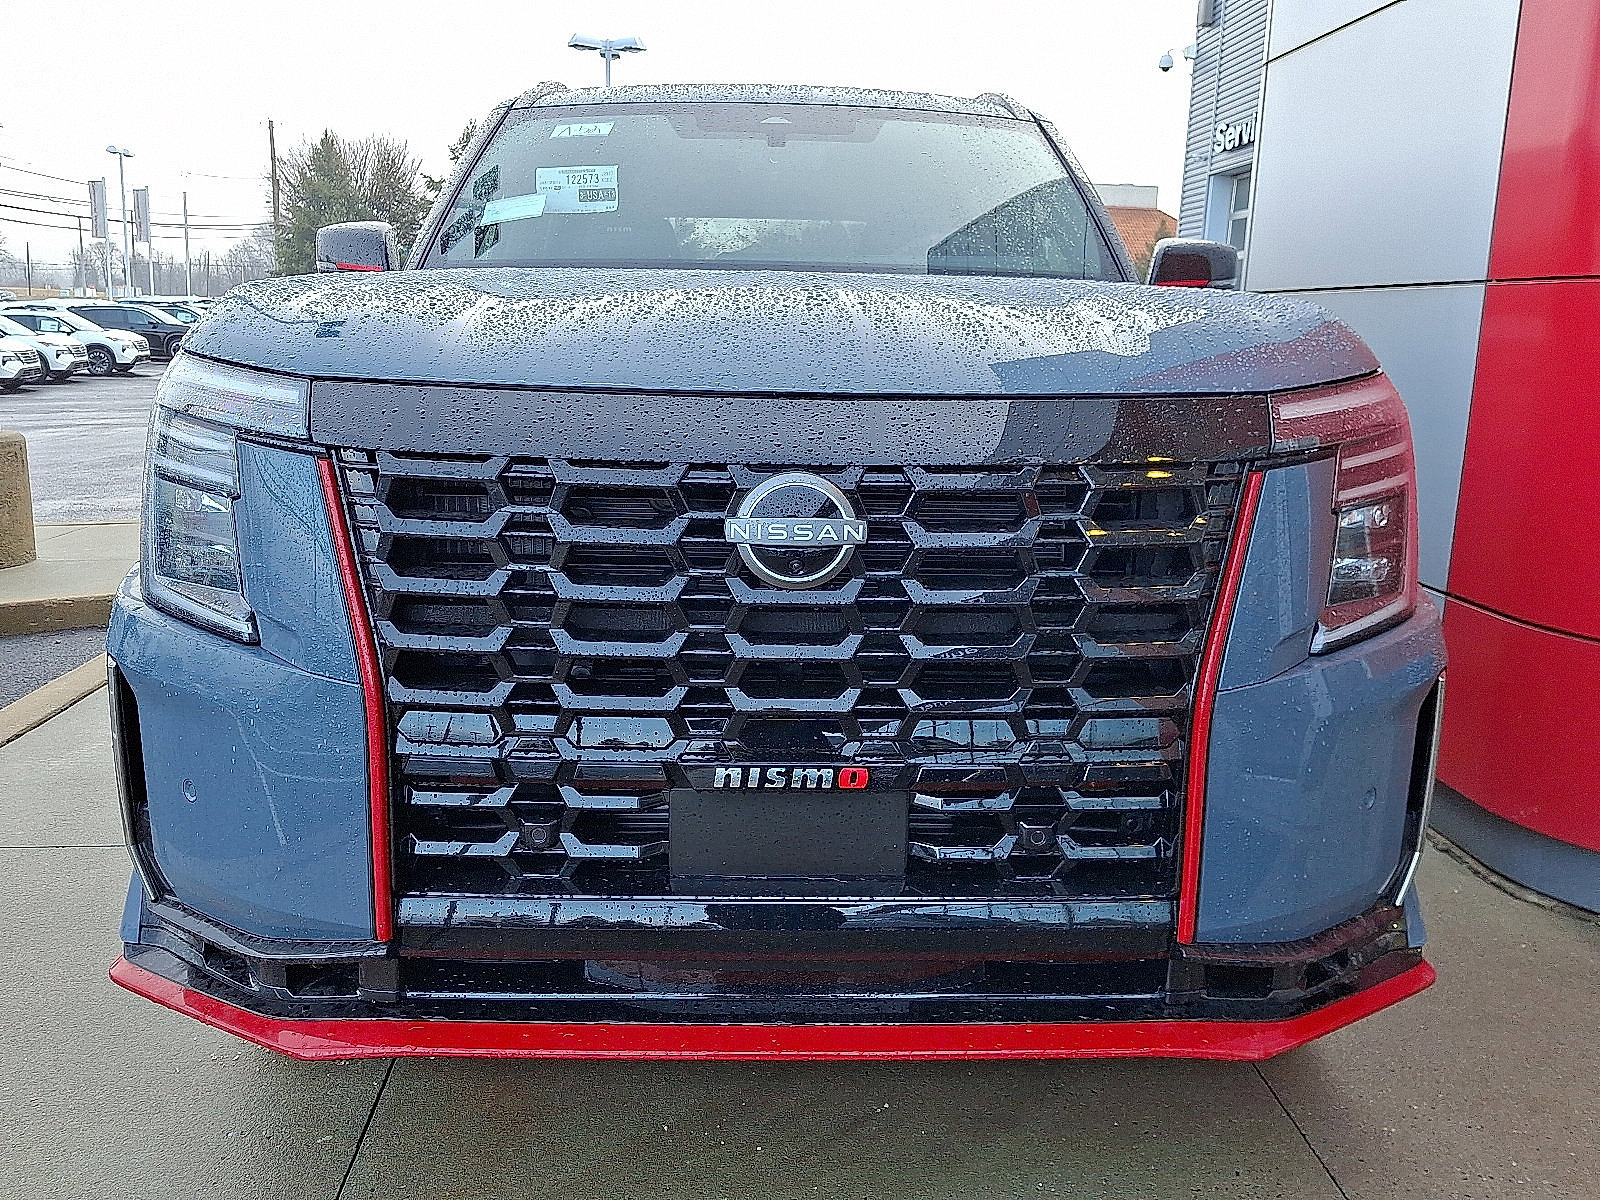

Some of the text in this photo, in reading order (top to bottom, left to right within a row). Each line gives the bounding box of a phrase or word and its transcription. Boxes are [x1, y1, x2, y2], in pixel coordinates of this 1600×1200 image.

[566, 173, 600, 185] 122573
[730, 523, 864, 541] NISSAN
[713, 767, 869, 789] nismo
